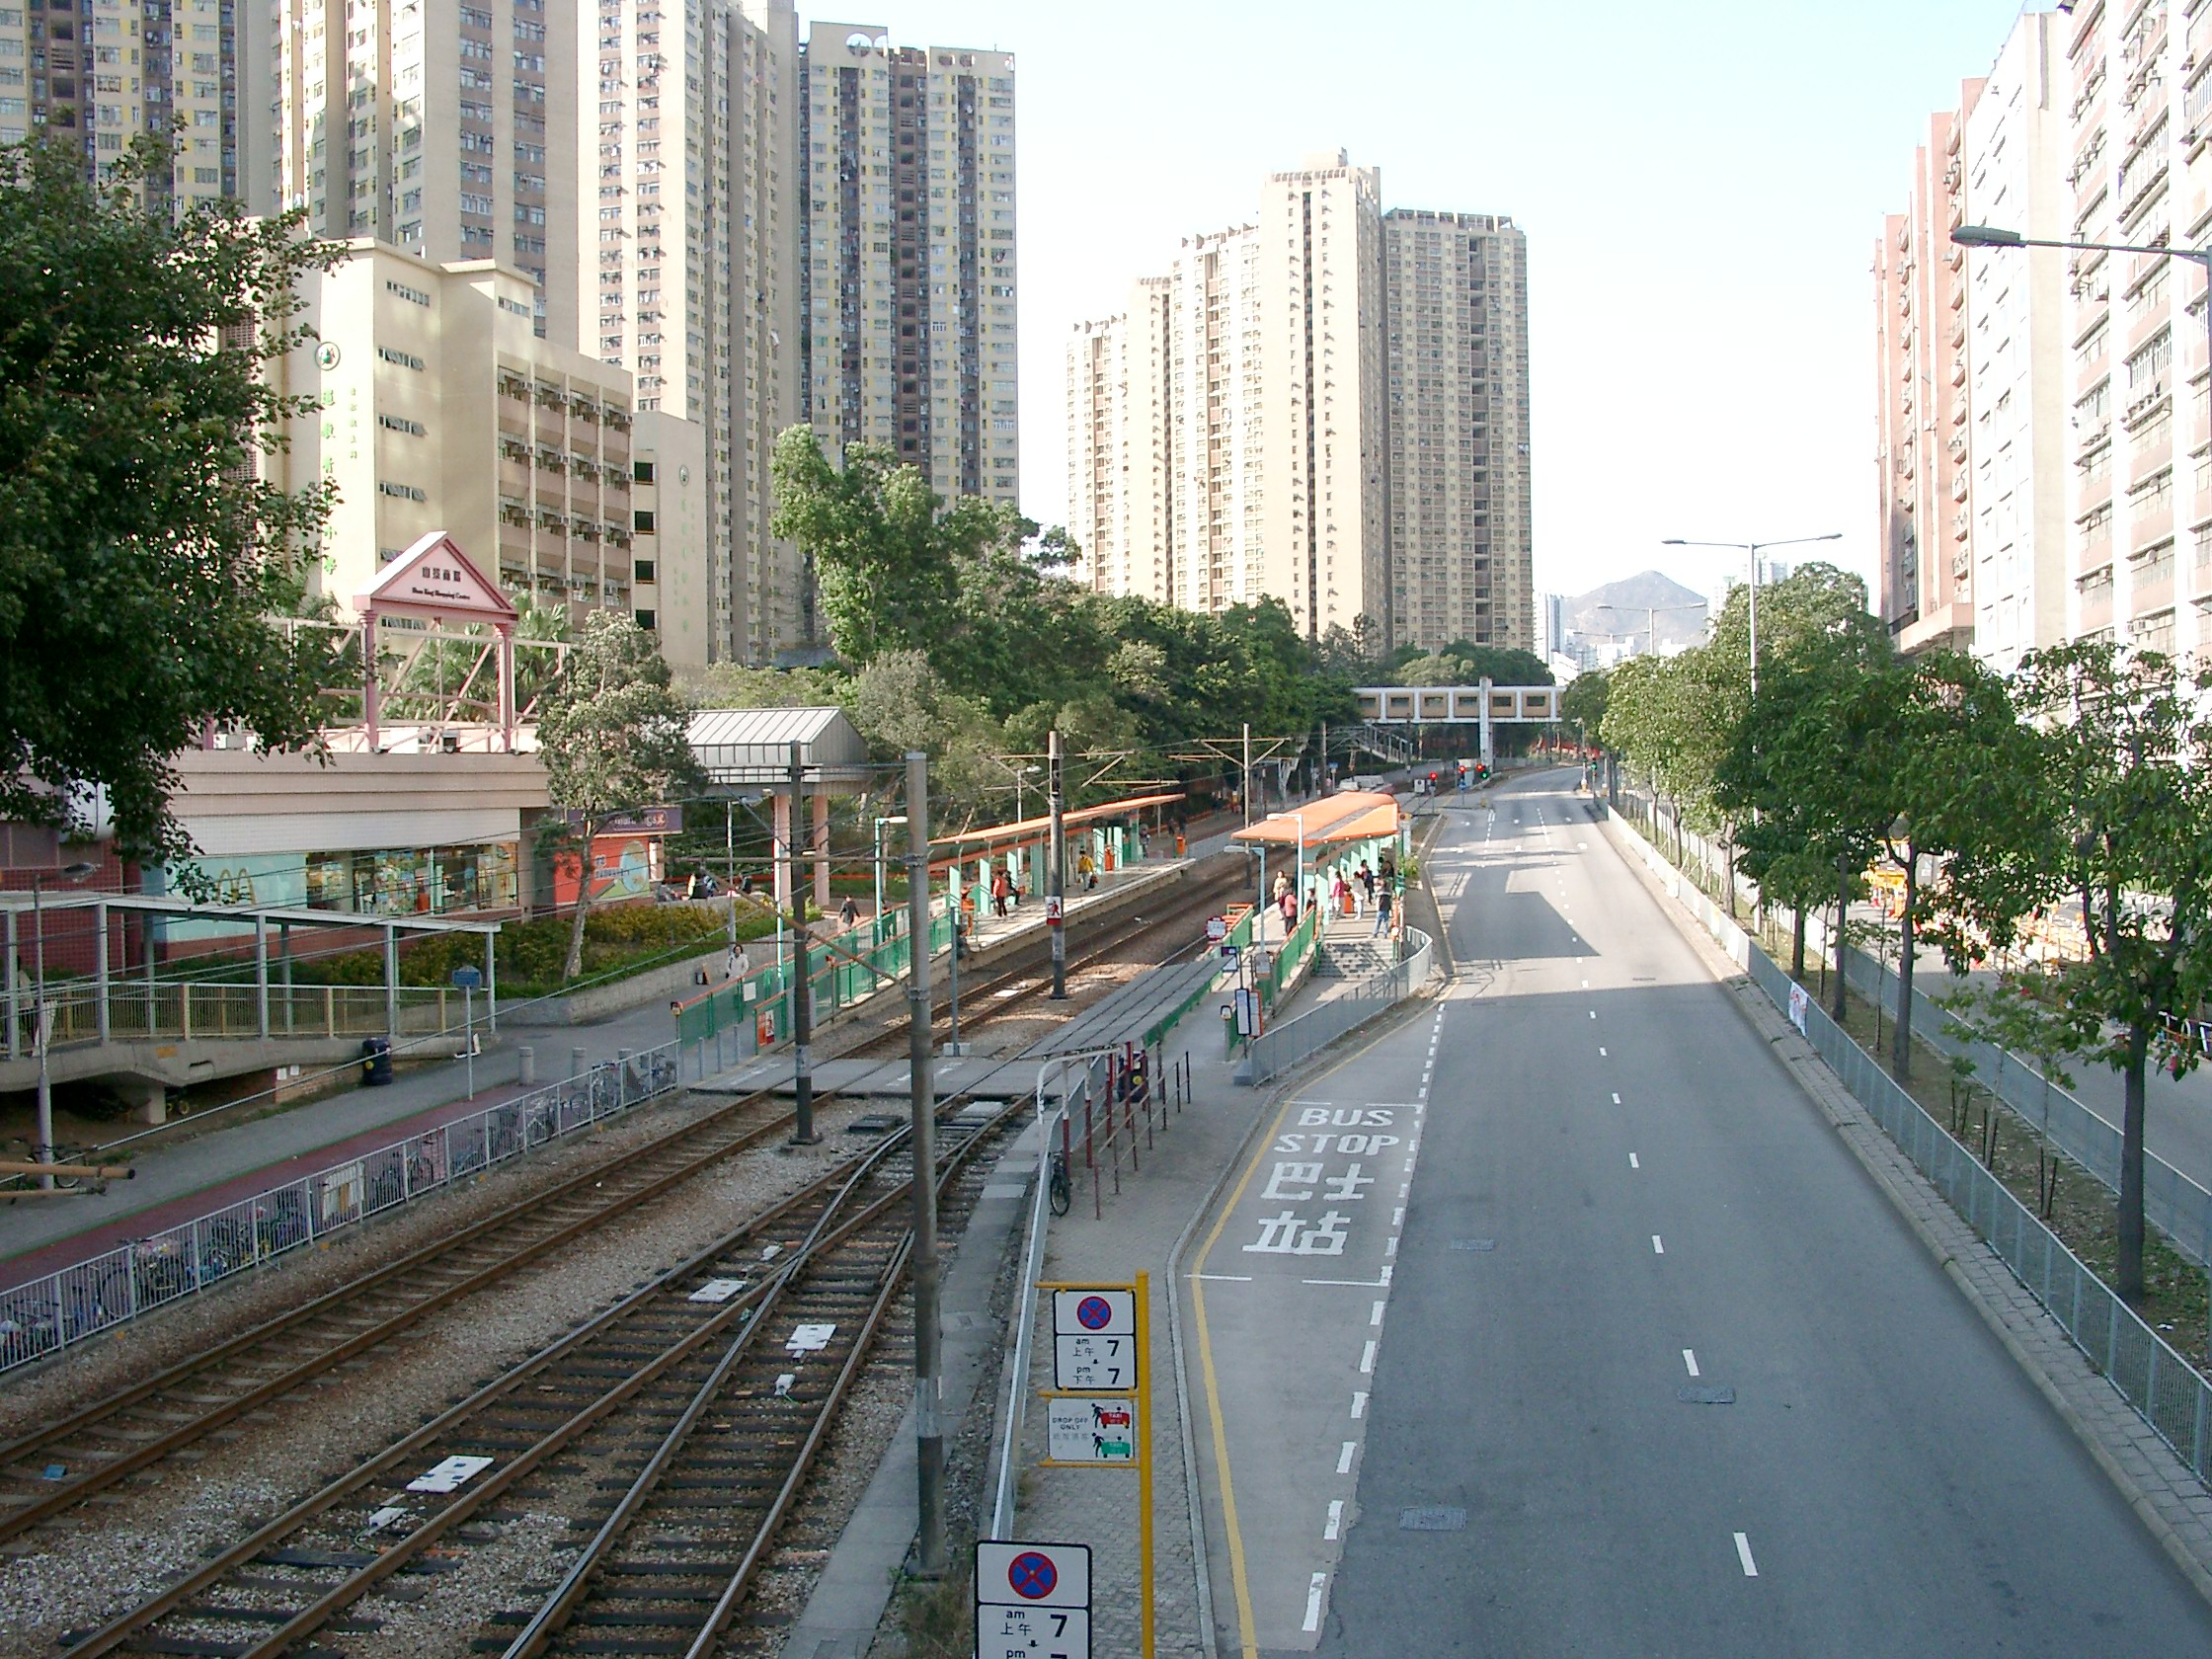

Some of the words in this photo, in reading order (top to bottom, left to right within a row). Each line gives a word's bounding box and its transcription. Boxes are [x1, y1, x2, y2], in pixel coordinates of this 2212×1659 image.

[1299, 1108, 1395, 1127] BUS
[1274, 1134, 1399, 1155] STOP
[1260, 1161, 1376, 1201] 巴士
[1242, 1211, 1351, 1255] 站
[1072, 1347, 1094, 1357] 上午
[1107, 1339, 1120, 1357] 7
[1072, 1375, 1095, 1384] 下午
[1107, 1368, 1120, 1384] 7
[1000, 1621, 1032, 1636] 上午
[1006, 1610, 1025, 1619] am
[1050, 1614, 1067, 1637] 7
[1006, 1649, 1026, 1659] pm
